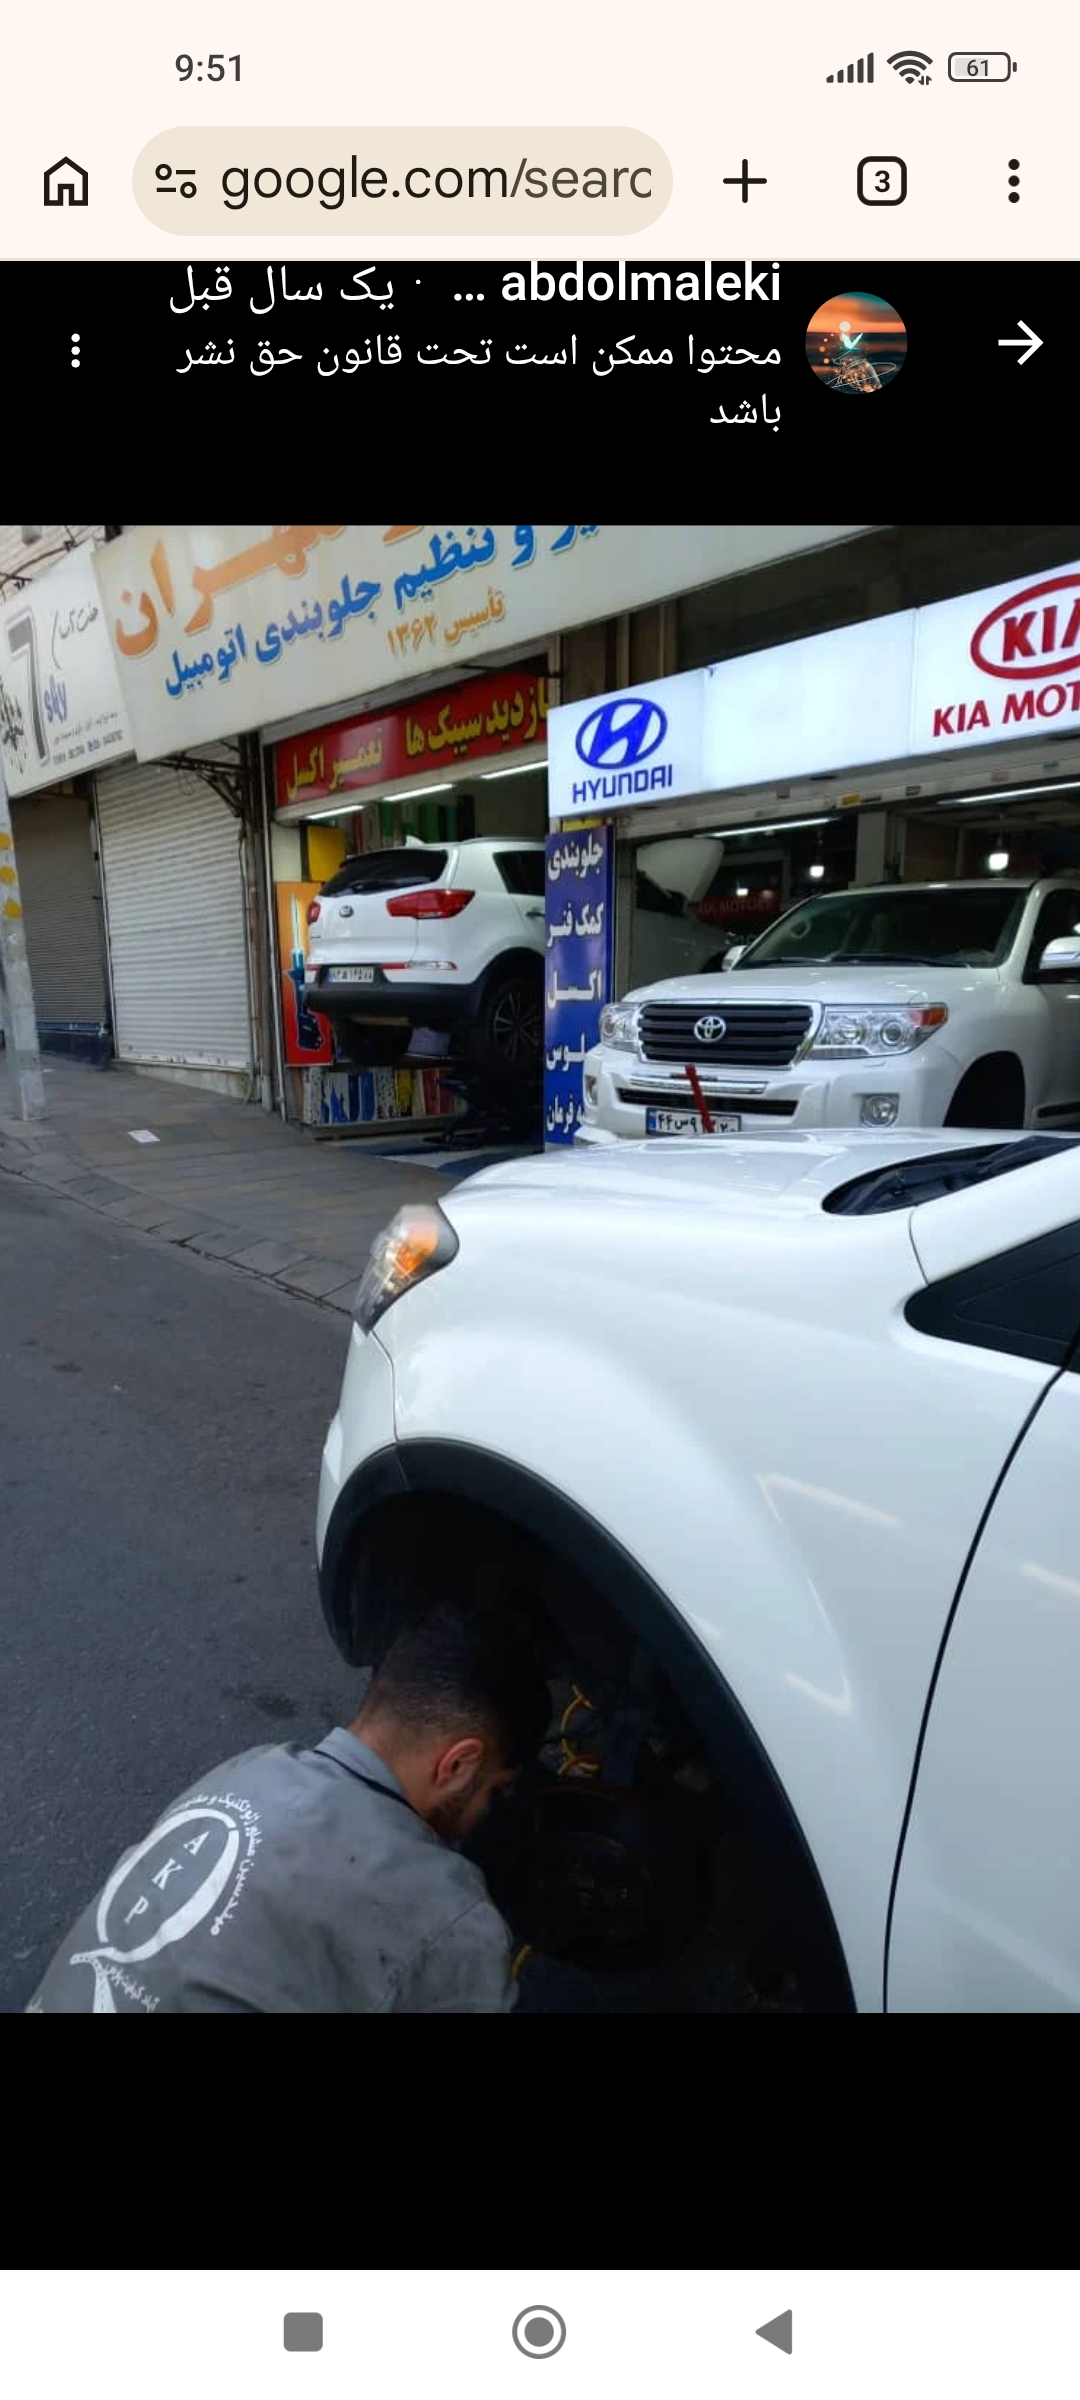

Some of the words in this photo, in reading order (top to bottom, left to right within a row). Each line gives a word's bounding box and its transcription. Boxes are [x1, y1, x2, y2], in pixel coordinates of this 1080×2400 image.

[175, 54, 244, 83] 9:51
[967, 59, 989, 77] 61
[221, 155, 652, 210] google.com/searc
[874, 170, 891, 193] 3
[169, 264, 233, 314] قبل
[249, 264, 323, 315] سال
[340, 265, 395, 311] یک
[501, 261, 781, 302] abdolmaleki
[175, 338, 235, 374] نشر
[249, 340, 303, 377] حق
[317, 333, 403, 377] قانون
[416, 338, 493, 365] تحت
[505, 333, 577, 365] است
[592, 334, 674, 377] ممکن
[688, 333, 782, 374] محتوا
[709, 393, 781, 433] باشد
[256, 573, 382, 664] جلوبندی
[165, 622, 247, 698] اتومبیل
[932, 699, 990, 737] KIA
[286, 744, 324, 800] اکسل
[572, 763, 672, 804] HYUNDAI
[547, 832, 604, 881] جلوبندی
[547, 969, 603, 1010] اکسل
[545, 1032, 586, 1072] لوس
